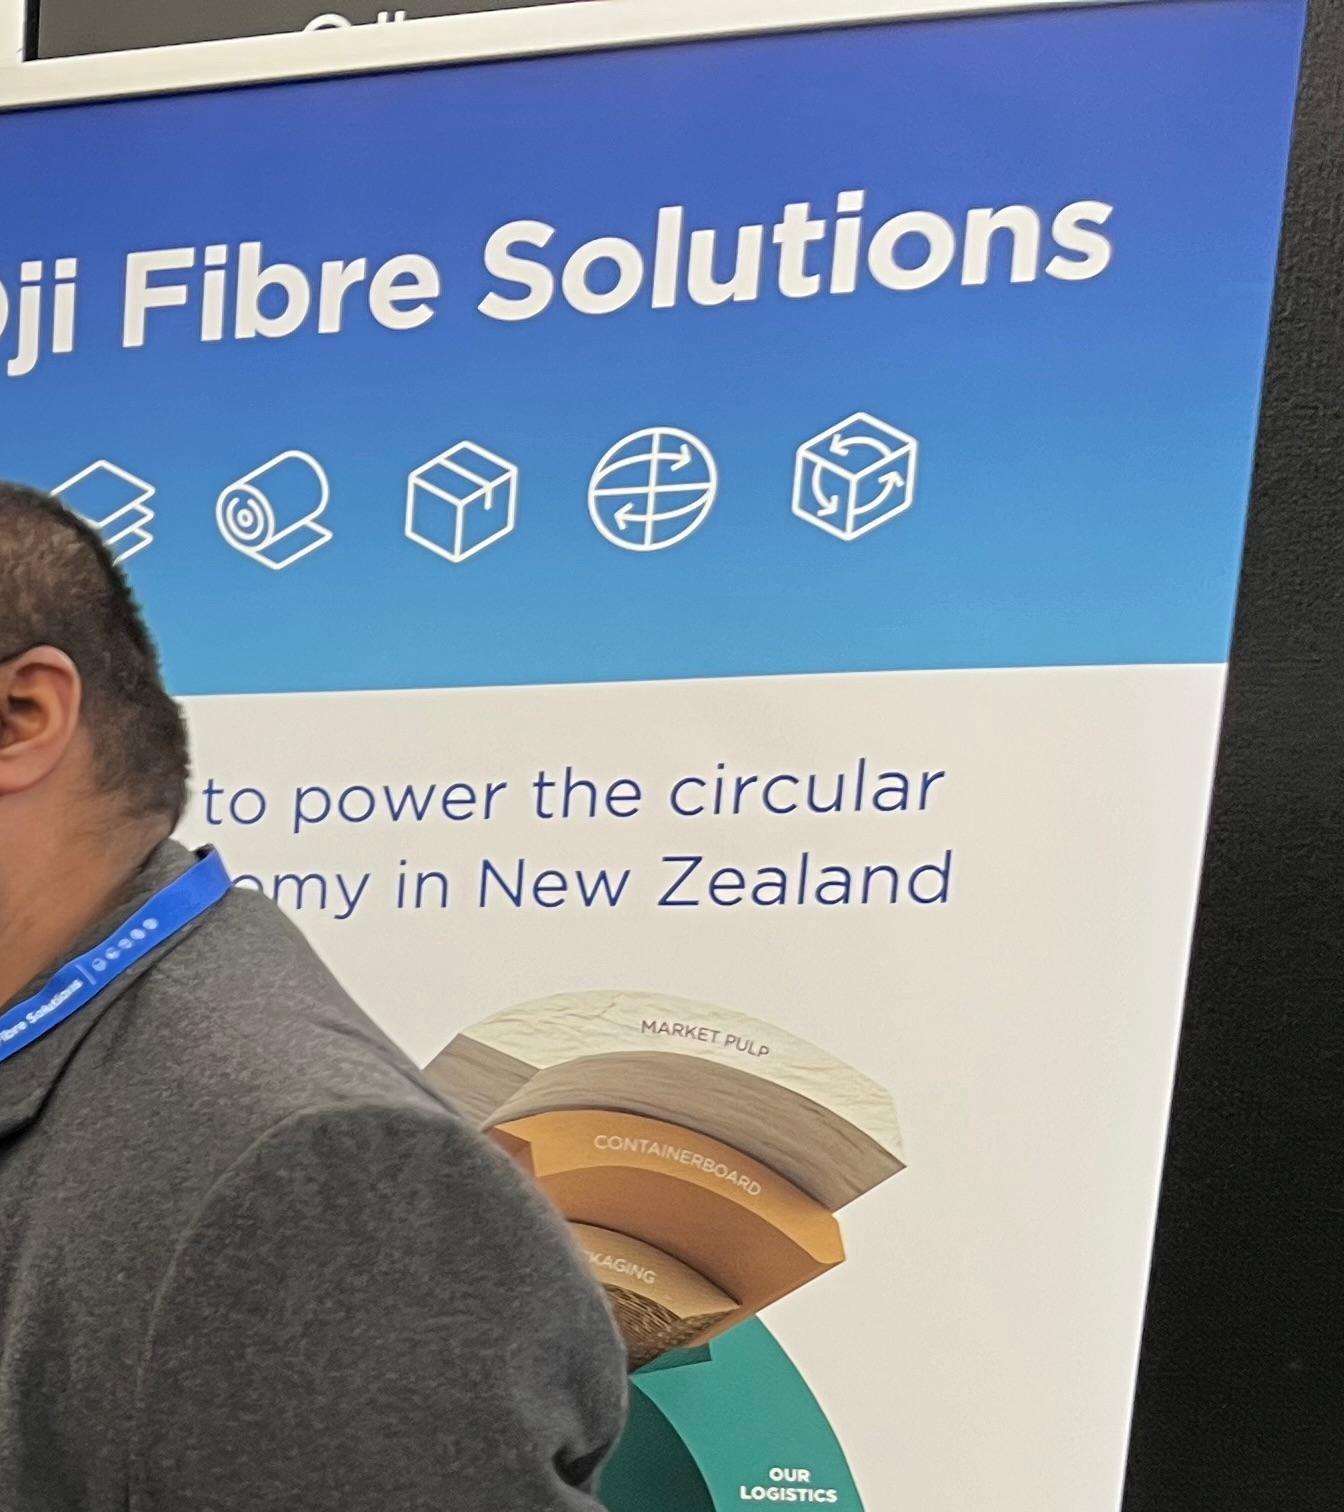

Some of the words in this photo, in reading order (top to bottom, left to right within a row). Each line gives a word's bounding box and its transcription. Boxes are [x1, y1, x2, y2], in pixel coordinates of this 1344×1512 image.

[123, 242, 441, 348] Fibre
[478, 190, 1114, 321] Solutions
[202, 779, 266, 826] to
[294, 777, 508, 834] power
[533, 767, 642, 819] the
[670, 757, 946, 816] circular
[397, 859, 448, 909] in
[479, 858, 631, 908] New
[658, 849, 952, 907] Zealand
[641, 1019, 721, 1043] MARKET
[723, 1033, 770, 1058] PULP
[593, 1134, 762, 1197] CONTAINERBOARD
[740, 1485, 838, 1503] LOGISTICS
[768, 1467, 811, 1483] OUR
